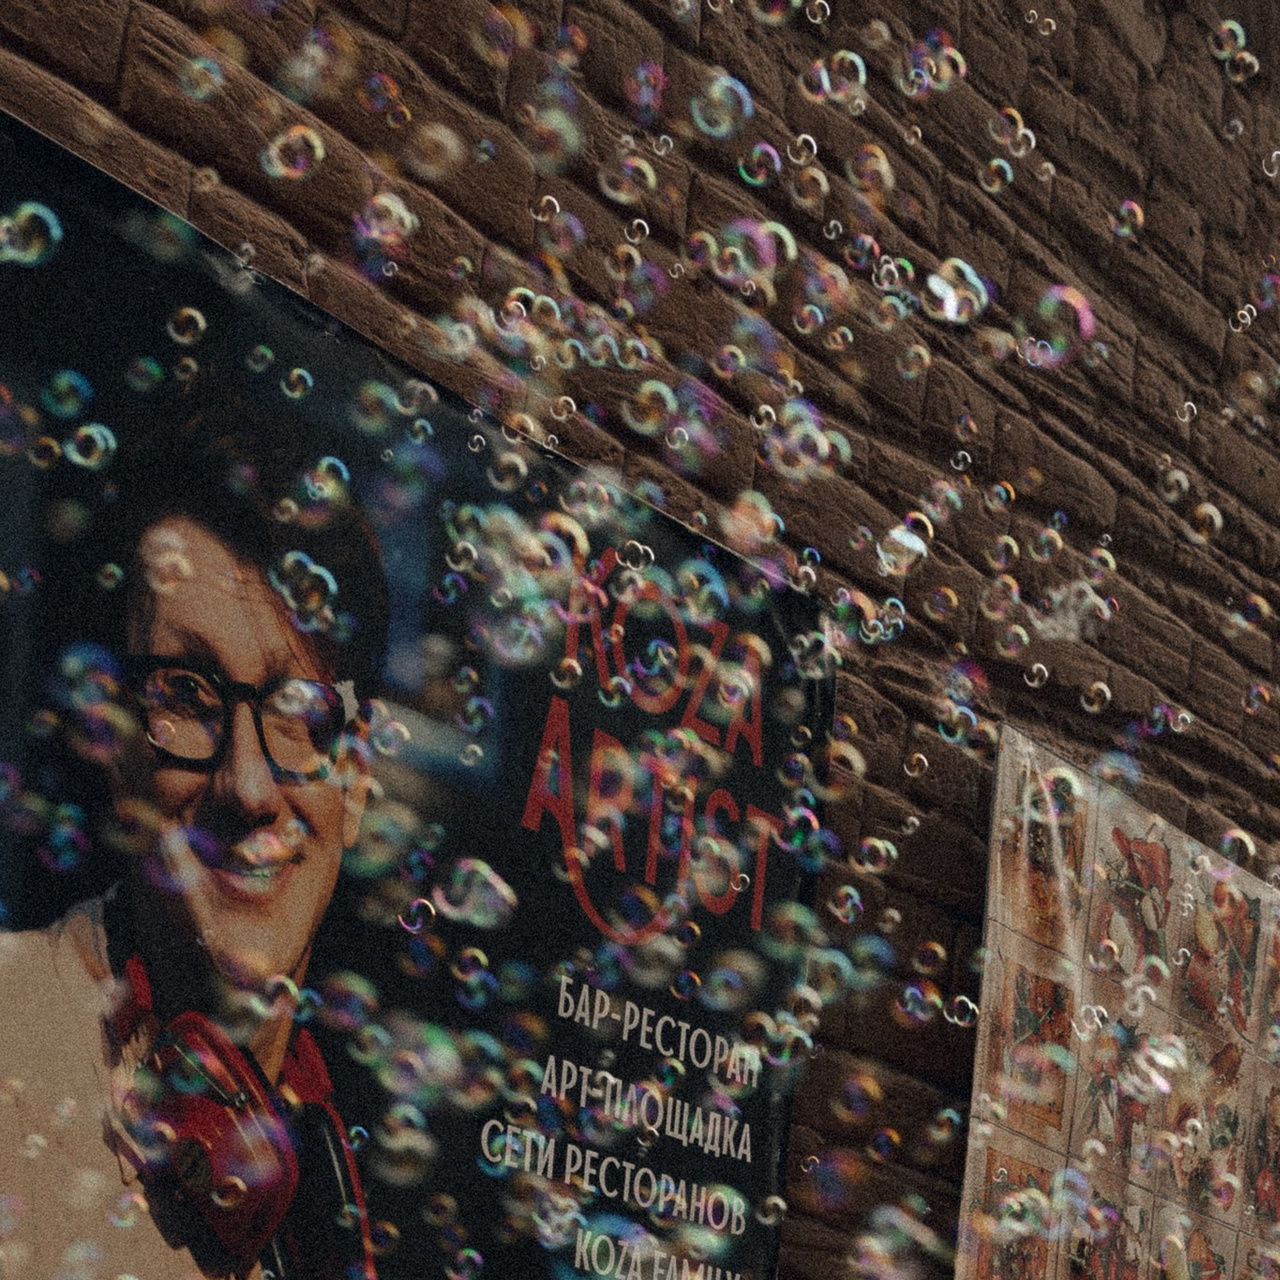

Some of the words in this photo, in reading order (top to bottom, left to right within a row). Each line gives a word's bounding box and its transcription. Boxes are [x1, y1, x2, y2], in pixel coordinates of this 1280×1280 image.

[557, 975, 759, 1088] БАР-РЕСТОРАН
[540, 1055, 752, 1163] АРТ-ПЛОЩАДКА
[481, 1120, 555, 1180] СЕТИ
[564, 1144, 746, 1236] РЕСТОРАНОВ
